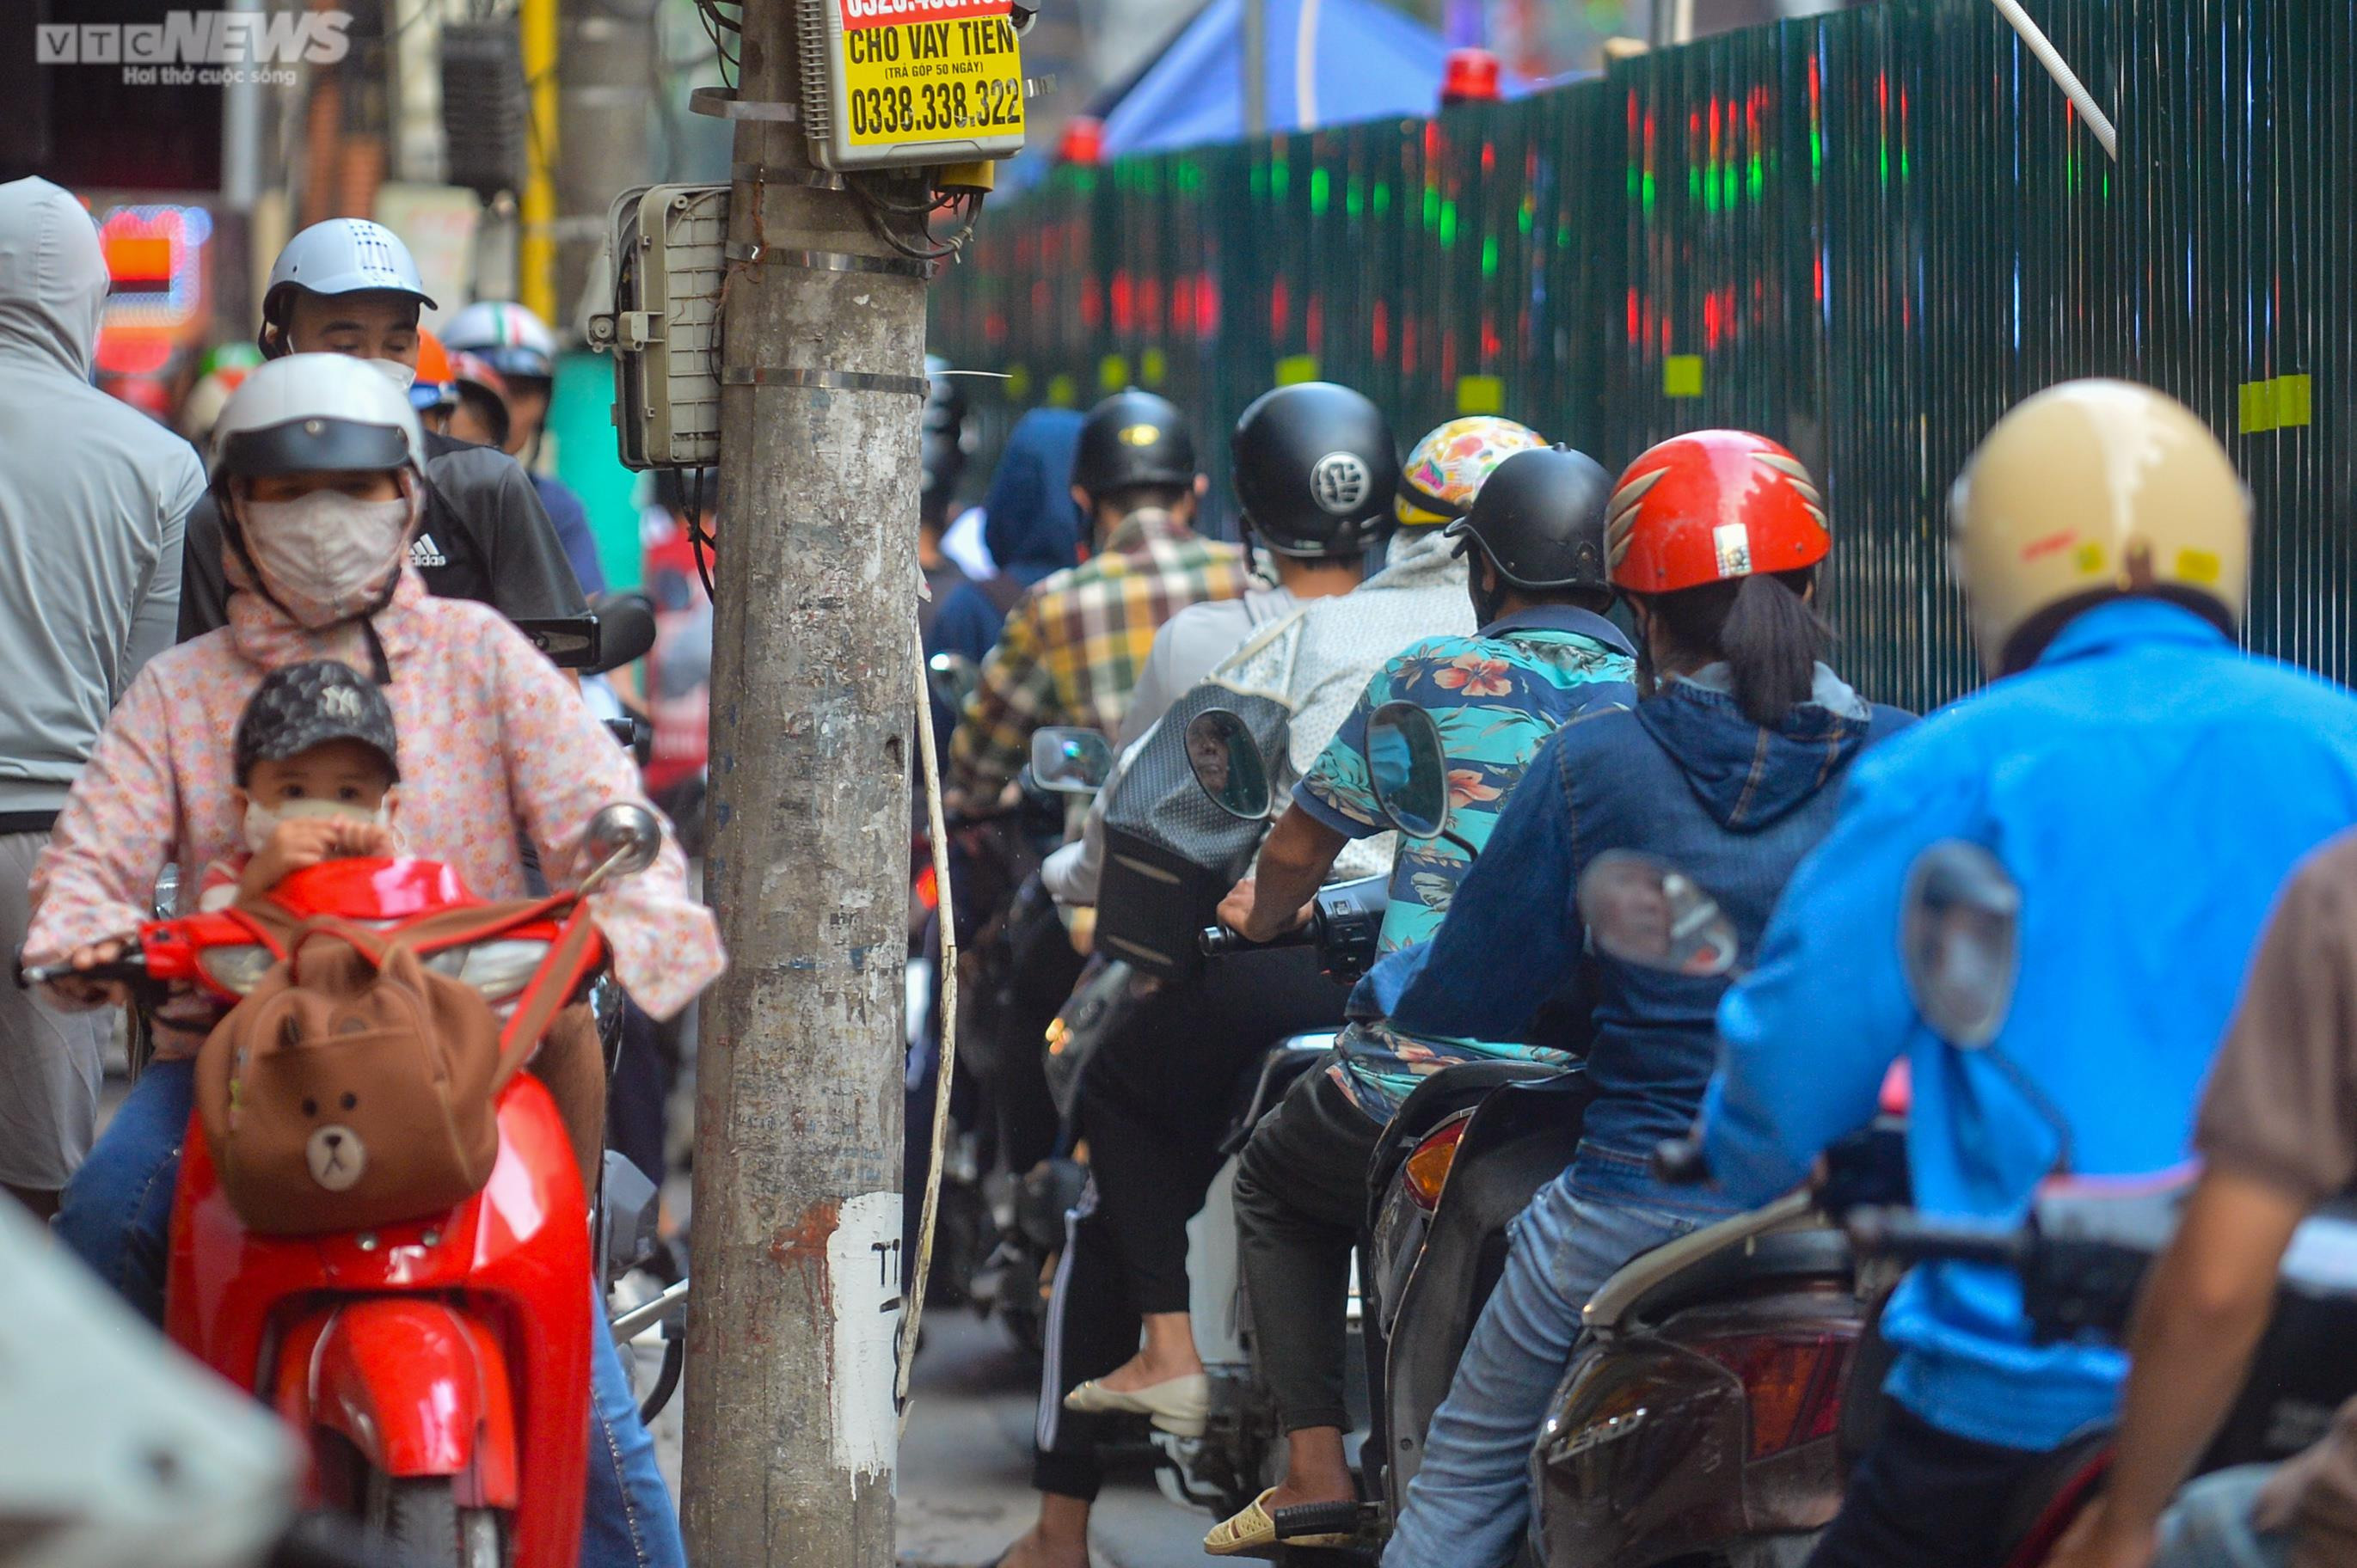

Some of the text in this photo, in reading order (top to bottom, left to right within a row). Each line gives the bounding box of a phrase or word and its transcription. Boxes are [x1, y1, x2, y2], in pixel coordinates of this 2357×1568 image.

[850, 26, 899, 64] CHO
[908, 22, 949, 59] VAY
[936, 64, 948, 75] 50
[852, 78, 1021, 135] 0338.338.322
